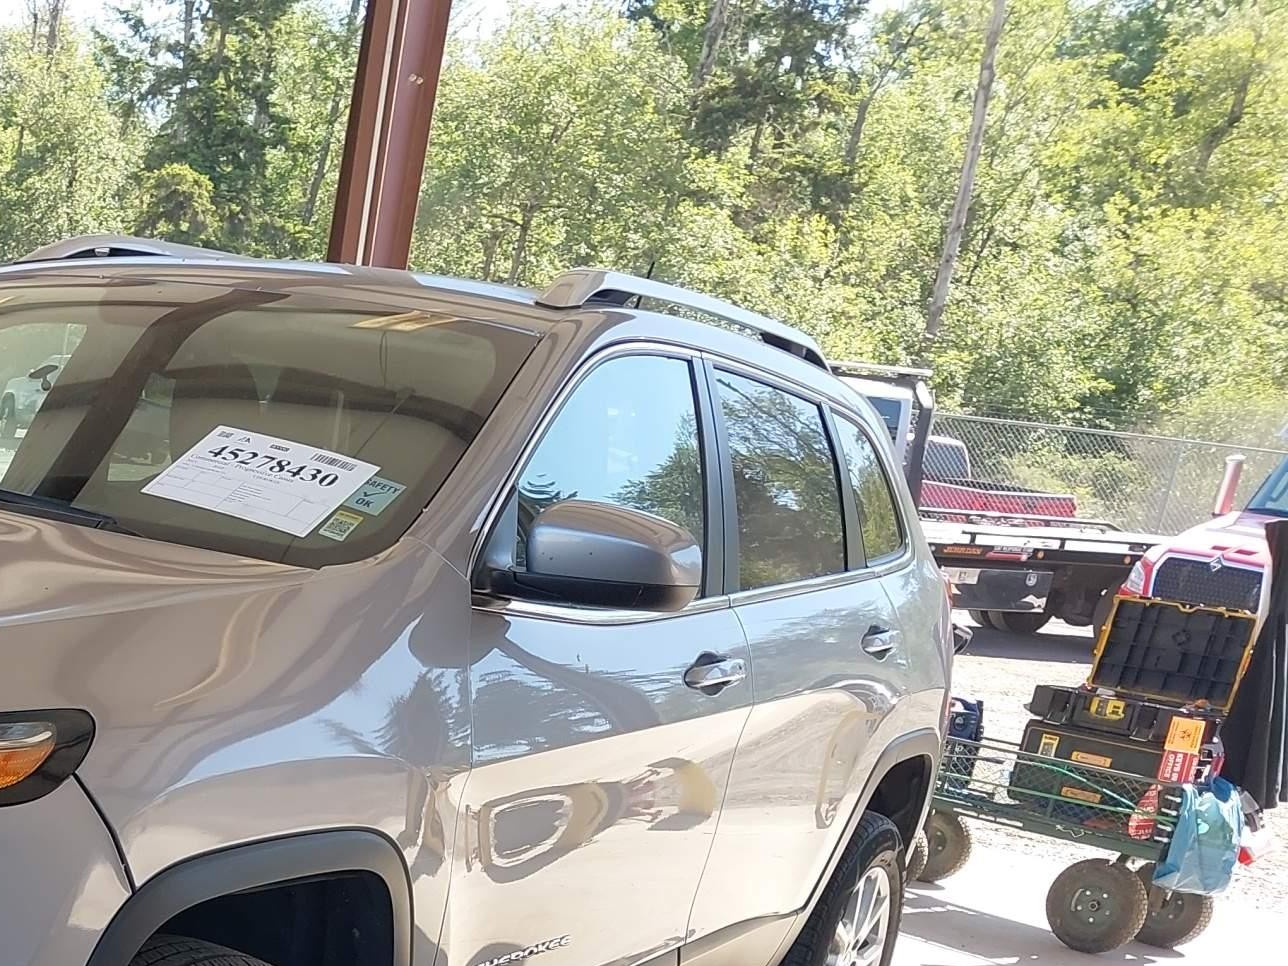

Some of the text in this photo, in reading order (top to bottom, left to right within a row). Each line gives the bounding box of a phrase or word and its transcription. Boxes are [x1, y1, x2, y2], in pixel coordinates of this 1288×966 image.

[208, 445, 339, 487] 45278430
[365, 478, 400, 494] SAFETY
[355, 497, 375, 508] OK
